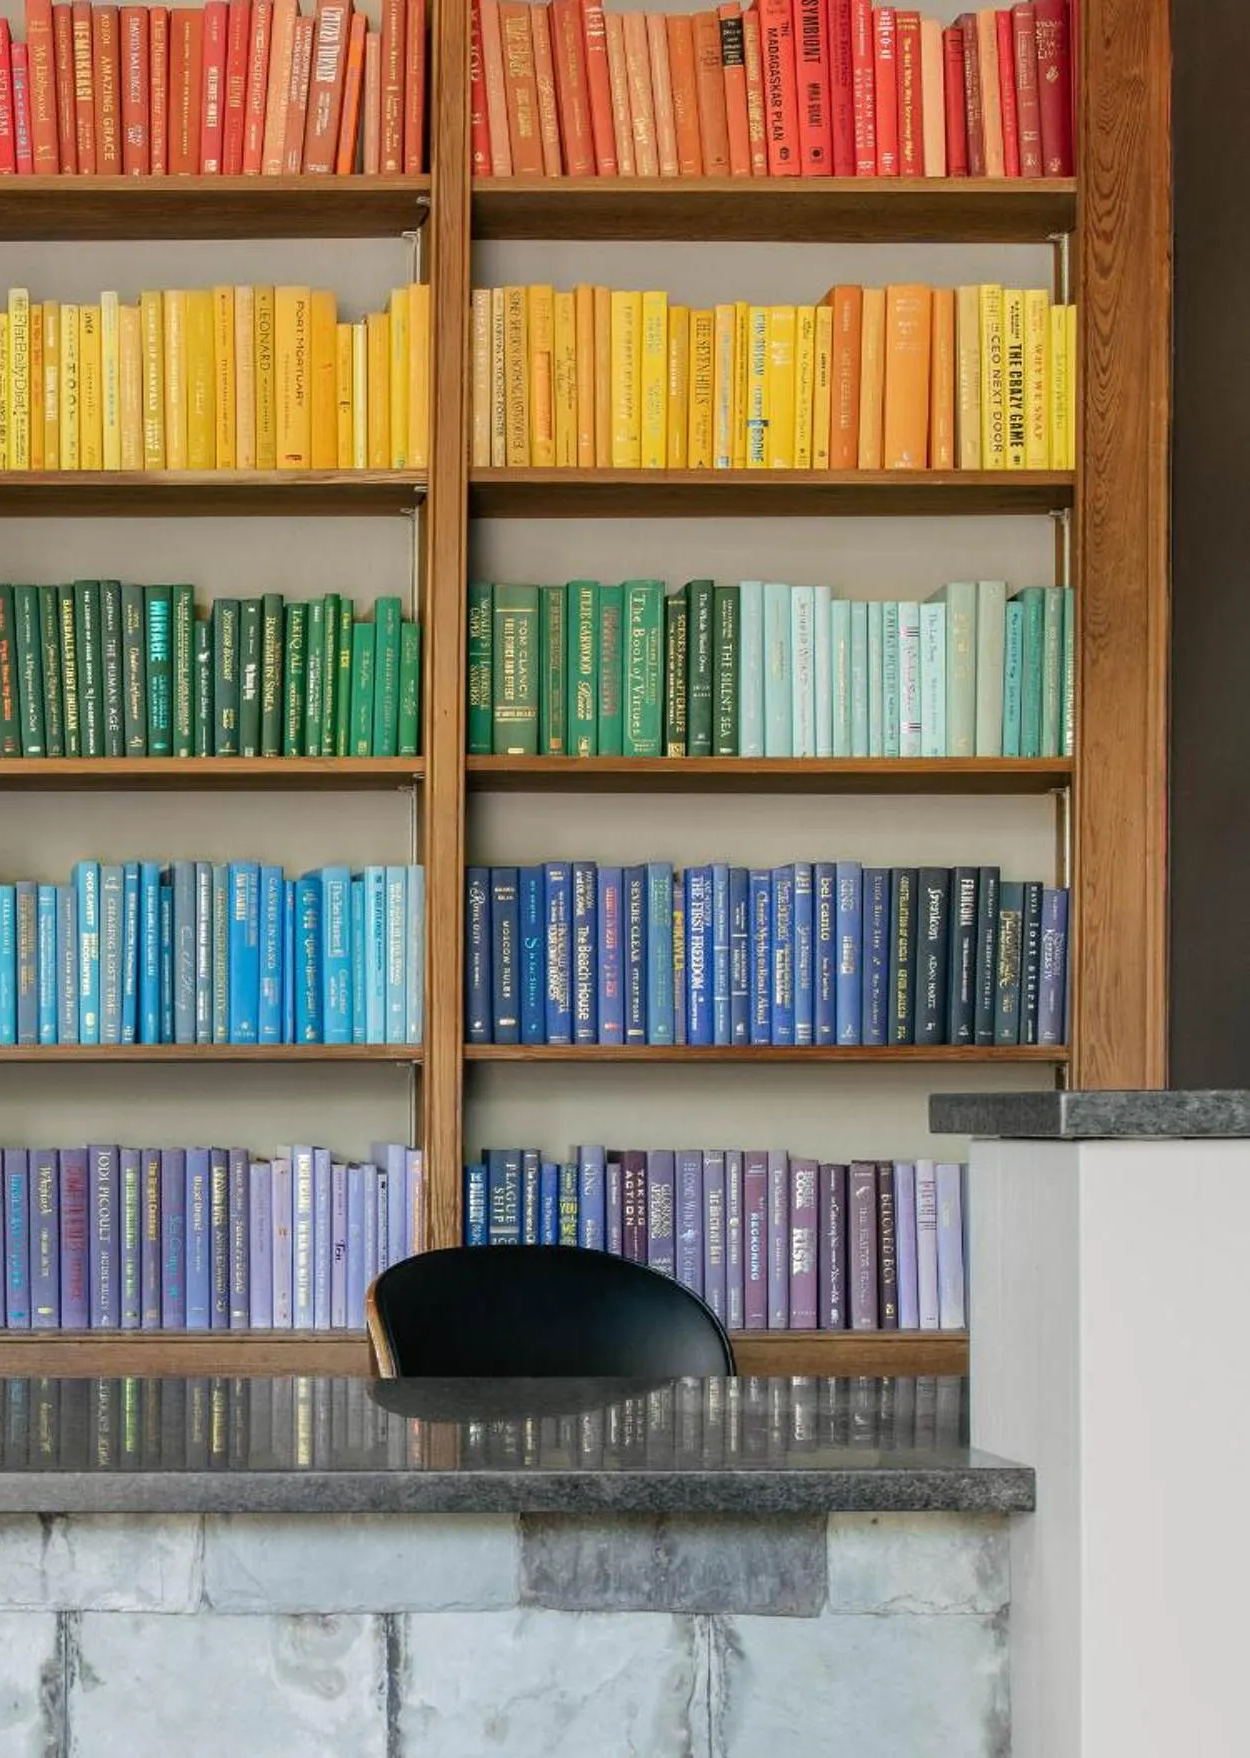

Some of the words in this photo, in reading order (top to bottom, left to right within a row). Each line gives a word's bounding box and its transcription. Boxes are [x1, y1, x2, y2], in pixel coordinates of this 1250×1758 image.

[801, 0, 821, 64] SYMBIONT
[100, 56, 114, 112] AMAZING
[768, 28, 784, 107] MADAGASKAR
[102, 117, 115, 161] GRACE
[772, 111, 786, 141] PLAN
[295, 300, 305, 333] PORT
[259, 306, 271, 371] LEONARD
[991, 335, 1001, 363] CEO
[1009, 343, 1023, 366] THE
[295, 336, 305, 407] MORTUARY
[696, 341, 712, 374] SEVEN
[695, 374, 712, 405] HILLS
[992, 369, 1003, 406] NEXT
[1009, 370, 1023, 410] CRAZY
[993, 411, 1003, 452] DOOR
[1010, 414, 1025, 448] GAME
[632, 597, 646, 622] The
[150, 600, 168, 662] MIRAGE
[290, 609, 302, 649] TARIQ
[518, 619, 528, 647] TOM
[632, 629, 645, 664] Book
[677, 613, 686, 654] SCENES
[106, 640, 116, 658] THE
[291, 653, 303, 674] ALI
[579, 622, 593, 674] GARWOOD
[720, 644, 733, 669] THE
[65, 661, 76, 691] FIRST
[107, 662, 117, 703] HUMAN
[518, 648, 528, 700] CLANCY
[630, 668, 643, 680] of
[720, 672, 732, 712] SILENT
[67, 693, 77, 730] INDIAN
[265, 681, 276, 713] SIMLA
[632, 685, 644, 732] Virtues
[677, 679, 686, 733] AFTERLIFE
[109, 708, 119, 731] AGE
[721, 716, 732, 738] SEA
[630, 880, 640, 923] SEVERE
[691, 877, 703, 899] THE
[820, 878, 831, 899] bel
[960, 879, 974, 927] FRANCONA
[577, 925, 589, 943] The
[691, 902, 704, 933] FIRST
[821, 903, 832, 941] canto
[269, 940, 278, 969] SAND
[502, 920, 511, 964] MOSCOW
[631, 926, 640, 962] CLEAR
[1029, 923, 1039, 956] lost
[107, 954, 116, 981] LOST
[577, 945, 592, 981] Beach
[691, 935, 704, 989] FREEDOM
[502, 967, 511, 998] RULES
[1027, 965, 1037, 1010] stars
[106, 987, 116, 1016] TIME
[577, 983, 591, 1020] House
[758, 994, 769, 1025] Aloud
[98, 1152, 111, 1181] JODI
[684, 1162, 696, 1199] SECOND
[470, 1182, 484, 1224] DILBERT
[494, 1187, 505, 1223] SHIP
[506, 1163, 517, 1224] PLAGUE
[625, 1170, 634, 1226] ACTION
[637, 1168, 645, 1226] TAKING
[651, 1181, 662, 1239] APPEARING
[98, 1186, 111, 1243] PICOULT
[882, 1193, 893, 1254] BELOVED
[750, 1212, 760, 1281] RECKONING
[793, 1227, 807, 1275] RISK
